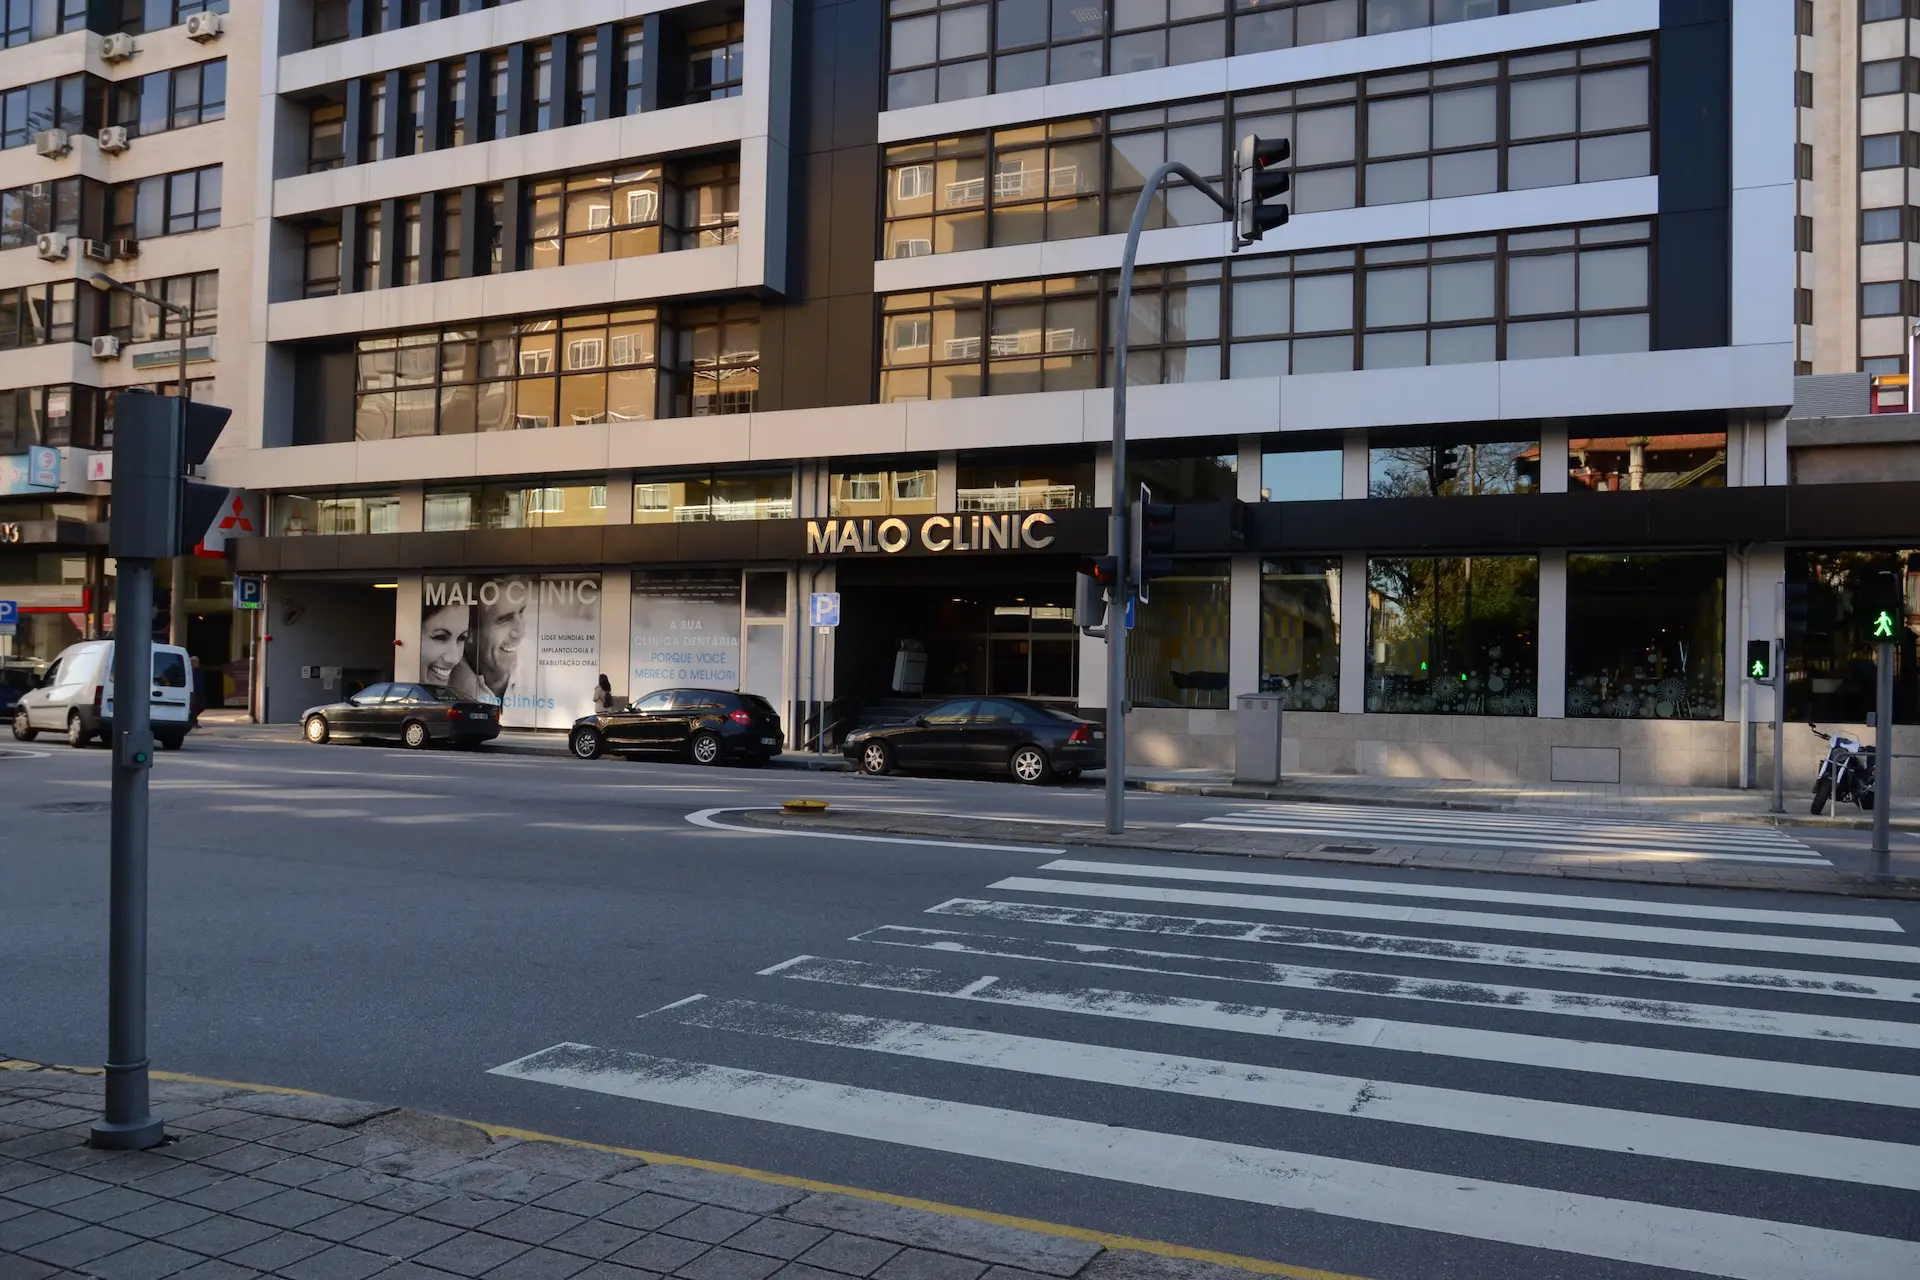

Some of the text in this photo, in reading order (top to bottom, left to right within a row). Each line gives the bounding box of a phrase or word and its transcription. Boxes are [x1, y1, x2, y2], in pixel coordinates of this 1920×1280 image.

[807, 517, 911, 554] MALO
[244, 581, 257, 600] P
[425, 581, 500, 606] MALO
[816, 596, 833, 623] P
[669, 620, 703, 630] A SUA
[683, 634, 738, 647] DENTÁRIA
[696, 651, 727, 664] VOCÊ
[634, 668, 675, 681] MERECE
[678, 669, 687, 680] O
